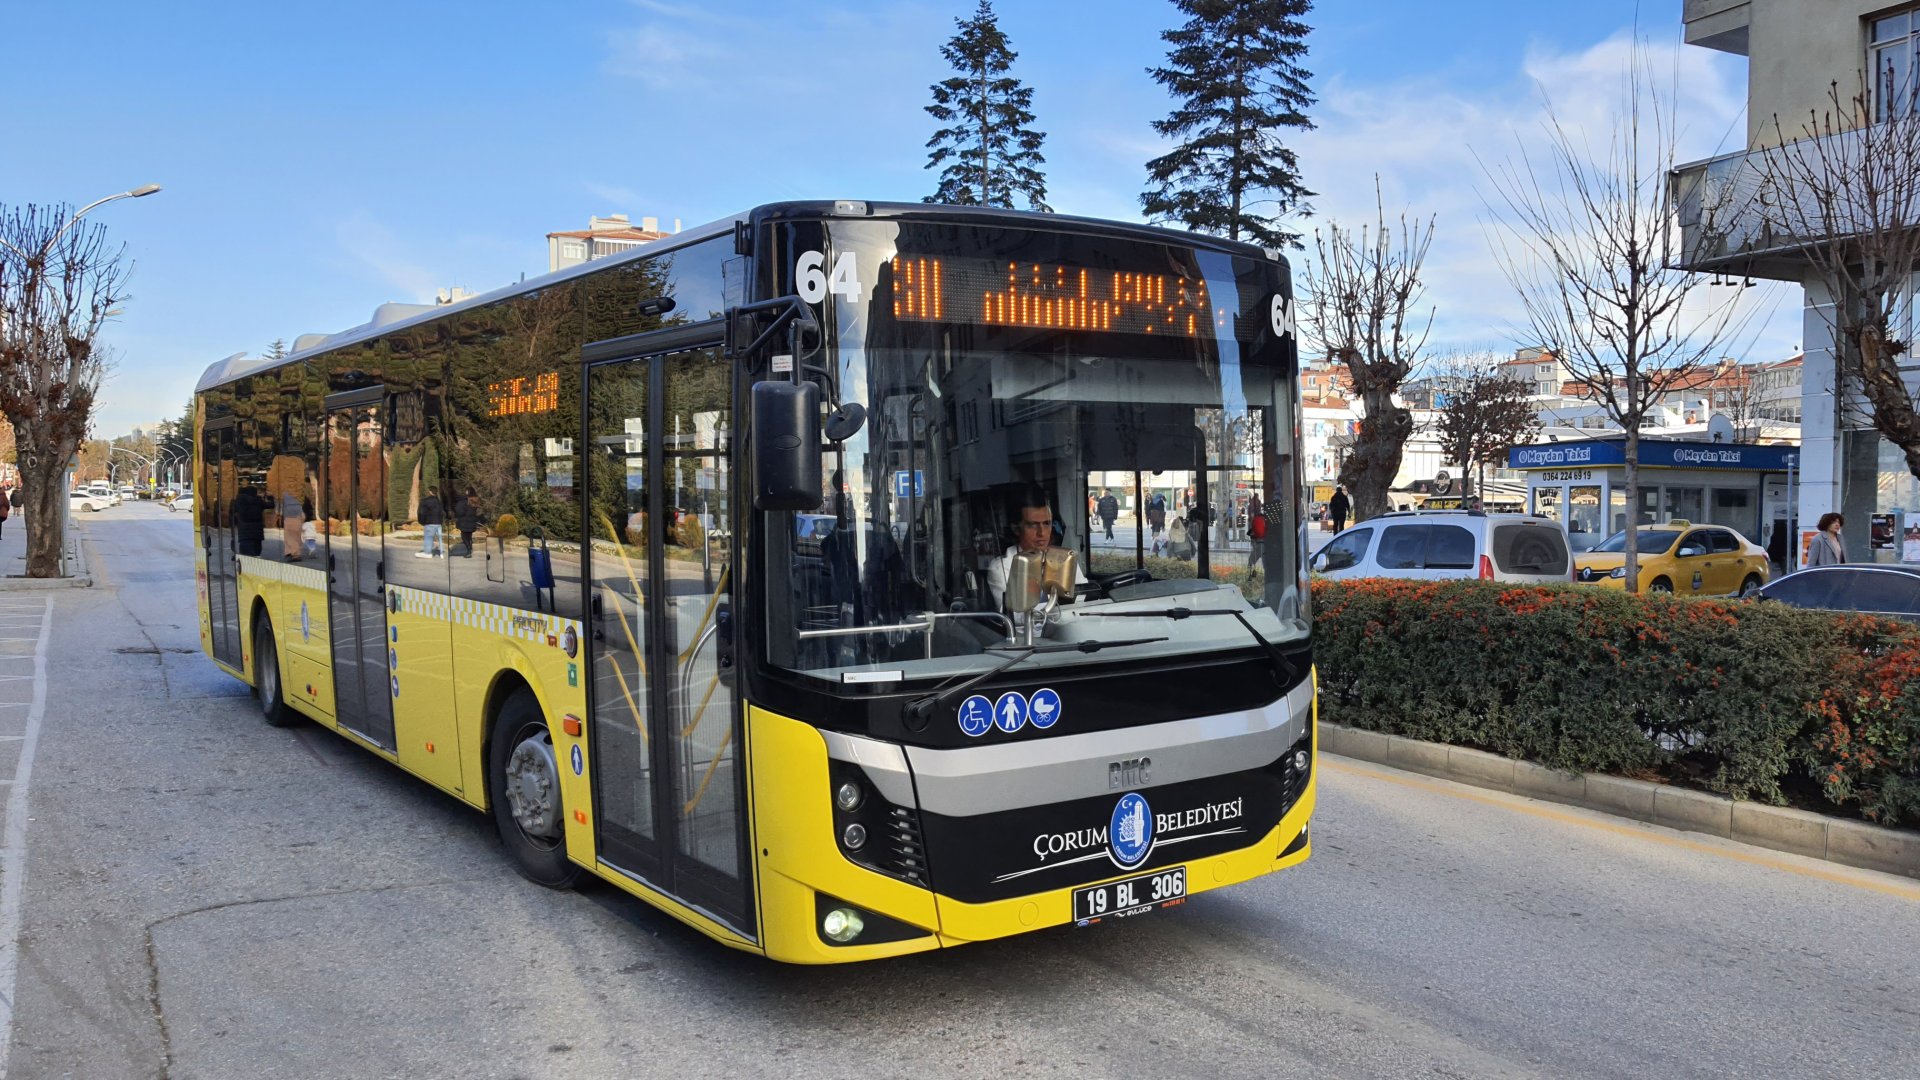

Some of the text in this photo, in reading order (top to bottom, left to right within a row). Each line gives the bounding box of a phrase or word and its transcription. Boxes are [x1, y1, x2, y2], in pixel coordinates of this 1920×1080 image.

[796, 250, 861, 304] 64
[1271, 293, 1295, 340] 64
[1528, 447, 1591, 465] Meydan Taksi
[1684, 450, 1741, 463] Meydan Taksi
[1543, 472, 1559, 481] 0364
[1560, 471, 1573, 480] 224
[1583, 470, 1591, 480] 19
[1109, 757, 1151, 788] BMC
[1033, 797, 1243, 861] ÇORUM BELEDİYESİ
[1087, 888, 1107, 914] 19
[1117, 882, 1139, 908] BL
[1151, 872, 1183, 900] 306
